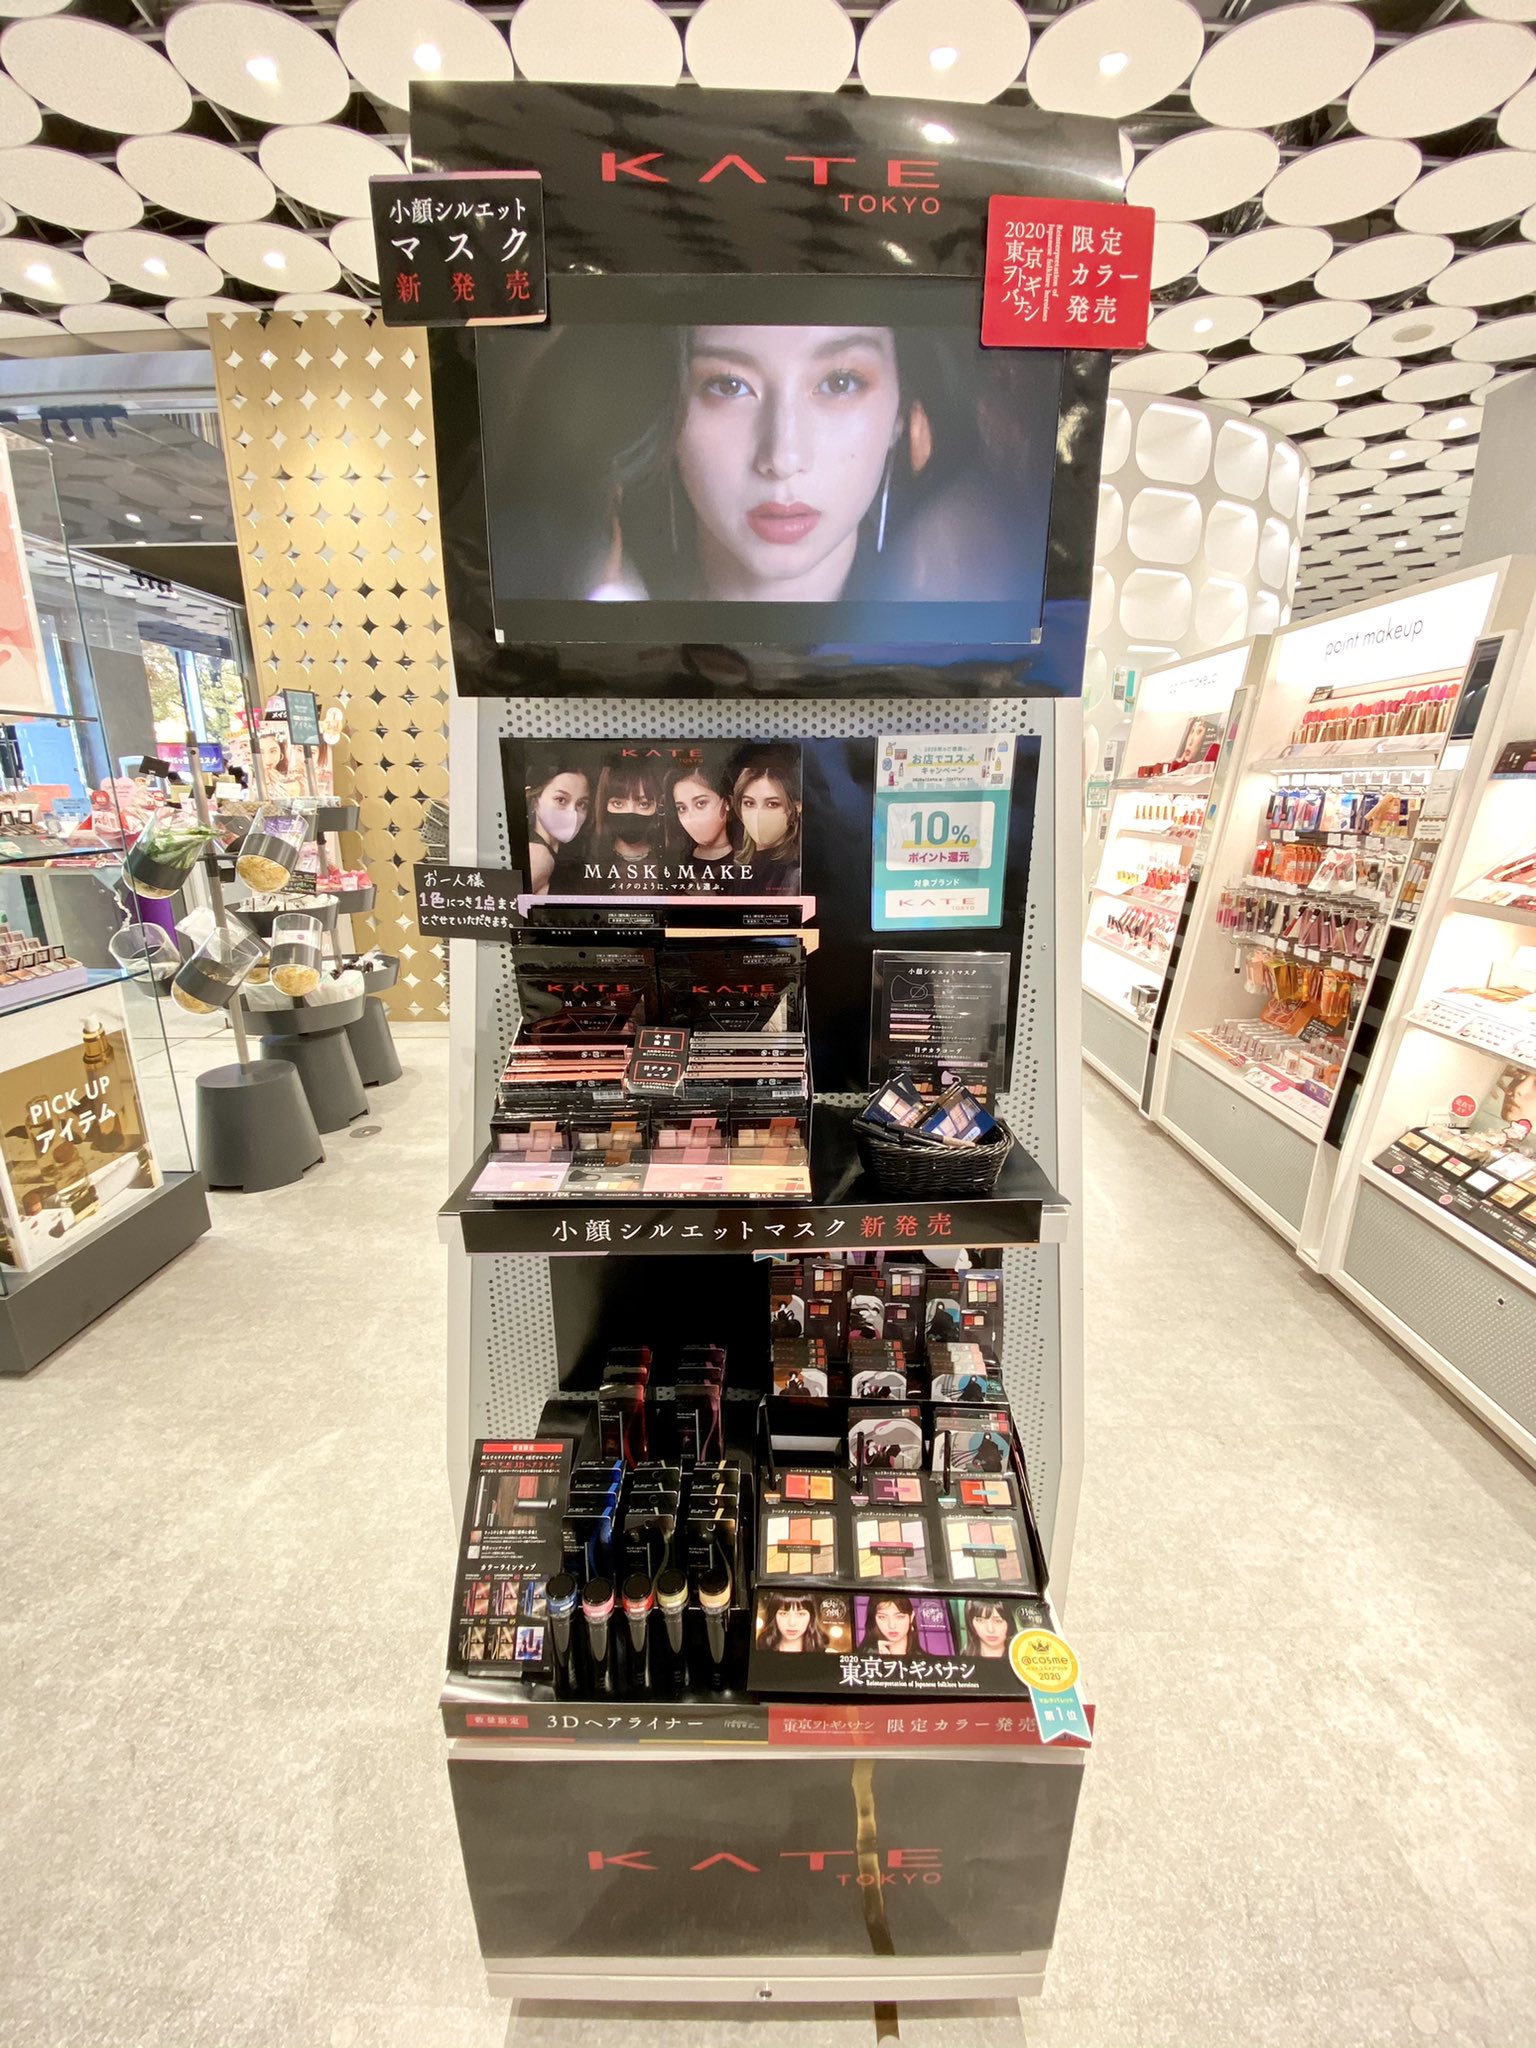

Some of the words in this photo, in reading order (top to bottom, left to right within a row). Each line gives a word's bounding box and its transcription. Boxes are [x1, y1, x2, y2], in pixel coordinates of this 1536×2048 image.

[600, 152, 940, 190] KATE
[389, 197, 526, 224] 小顔シルエット
[839, 193, 940, 215] TOKYO
[1004, 221, 1045, 239] 2020
[391, 228, 528, 263] マスク
[1071, 225, 1123, 256] 限定
[1069, 262, 1139, 288] カラー
[396, 269, 531, 303] 新発売
[1065, 295, 1117, 324] 発売
[1324, 632, 1360, 662] point
[1362, 617, 1424, 647] makeup
[622, 749, 703, 758] KATE
[912, 753, 975, 766] お店でコスメ
[921, 767, 965, 775] キャンペーン
[910, 810, 971, 846] 10%
[908, 851, 970, 863] ポイント還元
[424, 869, 486, 888] お一人様
[913, 878, 960, 888] 対象ブランド
[419, 891, 517, 911] 1色につき1点まで
[899, 897, 976, 907] KATE
[421, 914, 514, 929] とさせていただきます。
[547, 984, 630, 993] KATE
[692, 984, 775, 993] KATE
[30, 1088, 81, 1125] PICK
[84, 1076, 110, 1100] UP
[36, 1103, 116, 1154] アイテム
[552, 1218, 846, 1243] 小顔シルエットマスク
[859, 1213, 953, 1240] 新発売
[480, 1563, 537, 1571] カラーラインナップ
[839, 1655, 859, 1663] 2020
[1021, 1655, 1069, 1666] @cosme
[839, 1657, 976, 1686] 東京ヲトギバナシ
[1039, 1672, 1061, 1680] 2020
[475, 1716, 520, 1725] 数量限定
[546, 1715, 704, 1730] 3Dヘアライナー
[783, 1717, 876, 1733] 東京ヲトギバナシ
[587, 1848, 942, 1872] KATE
[836, 1872, 943, 1886] TOKYO
